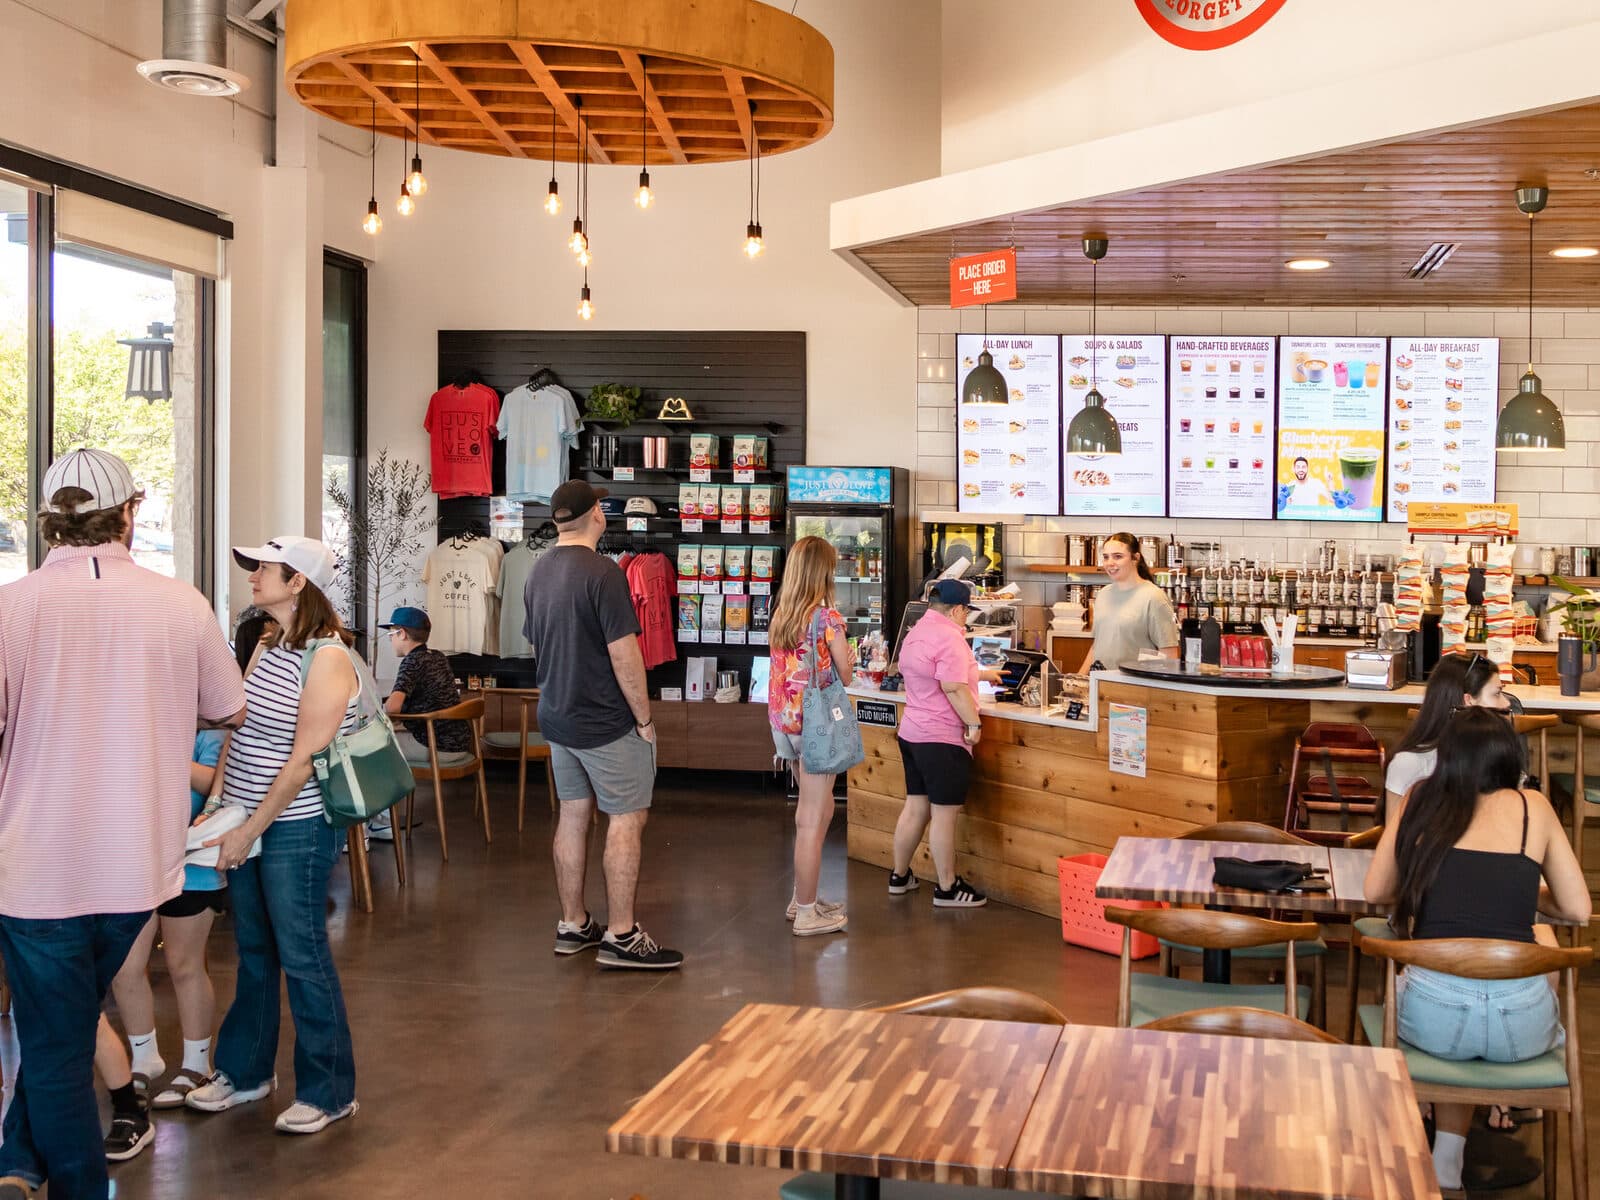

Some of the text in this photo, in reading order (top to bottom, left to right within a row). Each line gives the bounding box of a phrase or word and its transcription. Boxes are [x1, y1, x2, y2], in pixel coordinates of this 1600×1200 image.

[959, 259, 1006, 280] PLACE ORDER
[973, 280, 992, 296] HERE
[1011, 340, 1033, 349] LUNCH
[1084, 340, 1143, 350] SOUPS & SALADS
[1176, 341, 1270, 351] HAND-CRAFTED BEVERAGES
[1409, 343, 1480, 353] ALL-DAY BREAKFAST
[1118, 422, 1139, 432] REATS
[804, 480, 874, 490] JUST LOVE
[439, 570, 455, 587] JUST
[858, 709, 895, 723] STUD MUFFIN
